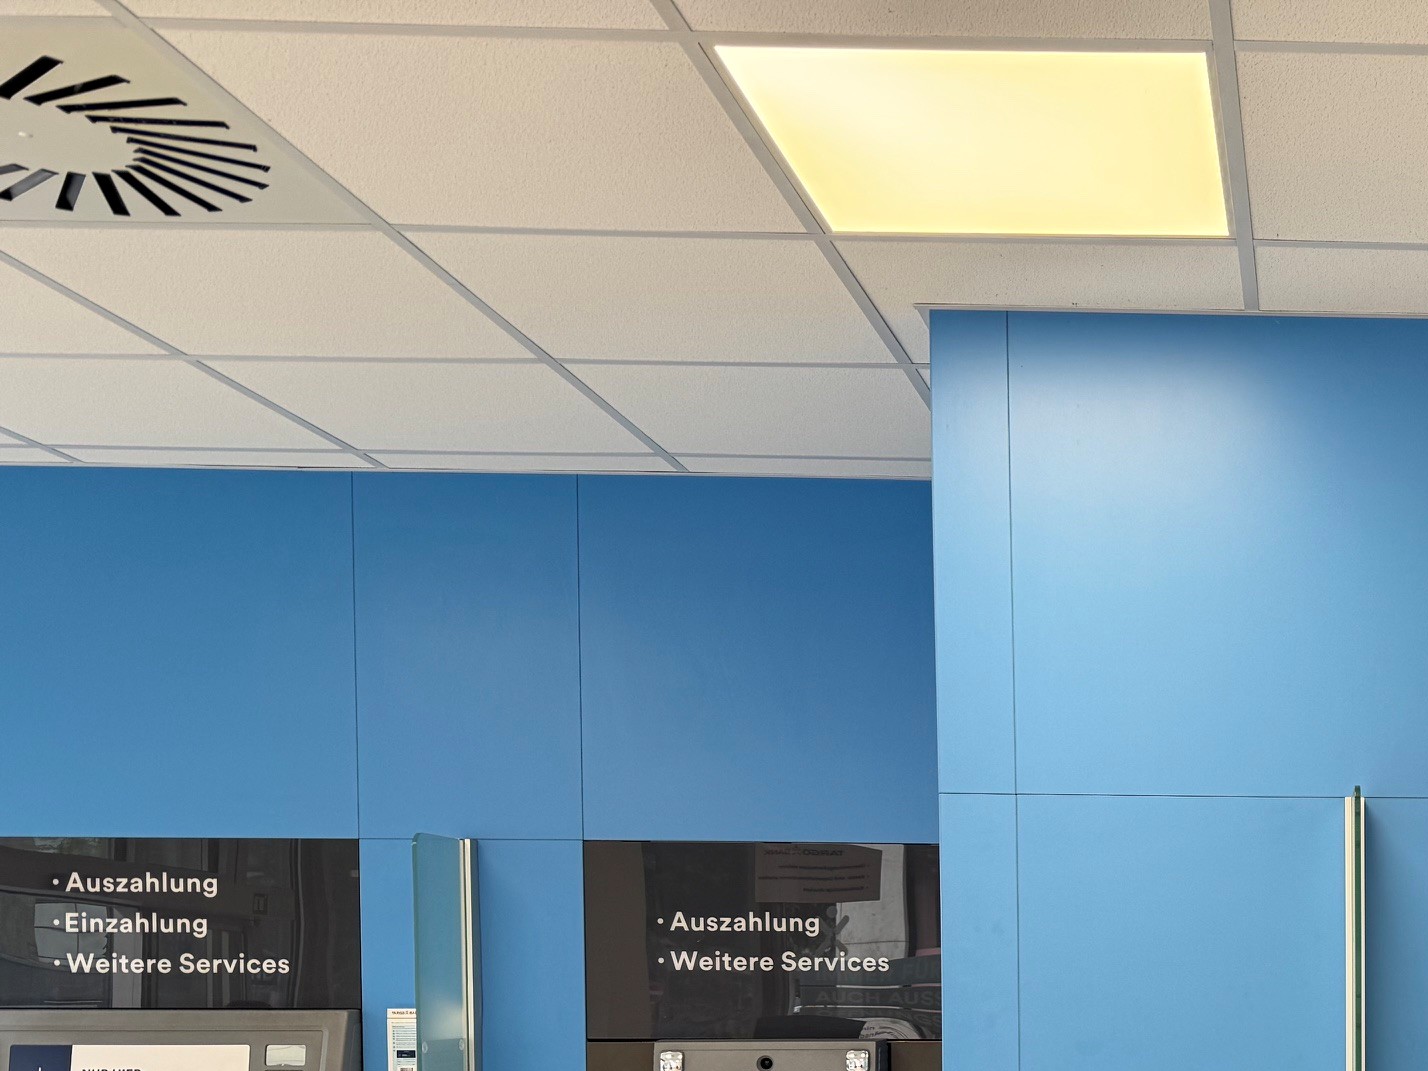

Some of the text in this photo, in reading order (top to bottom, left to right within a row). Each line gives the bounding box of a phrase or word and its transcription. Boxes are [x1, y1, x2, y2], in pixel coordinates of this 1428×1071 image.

[65, 871, 218, 898] Auszahlung
[65, 911, 208, 938] Einzahlung
[669, 911, 820, 937] Auszahlung
[66, 952, 290, 974] Weitere Services
[670, 950, 889, 972] Weitere Services
